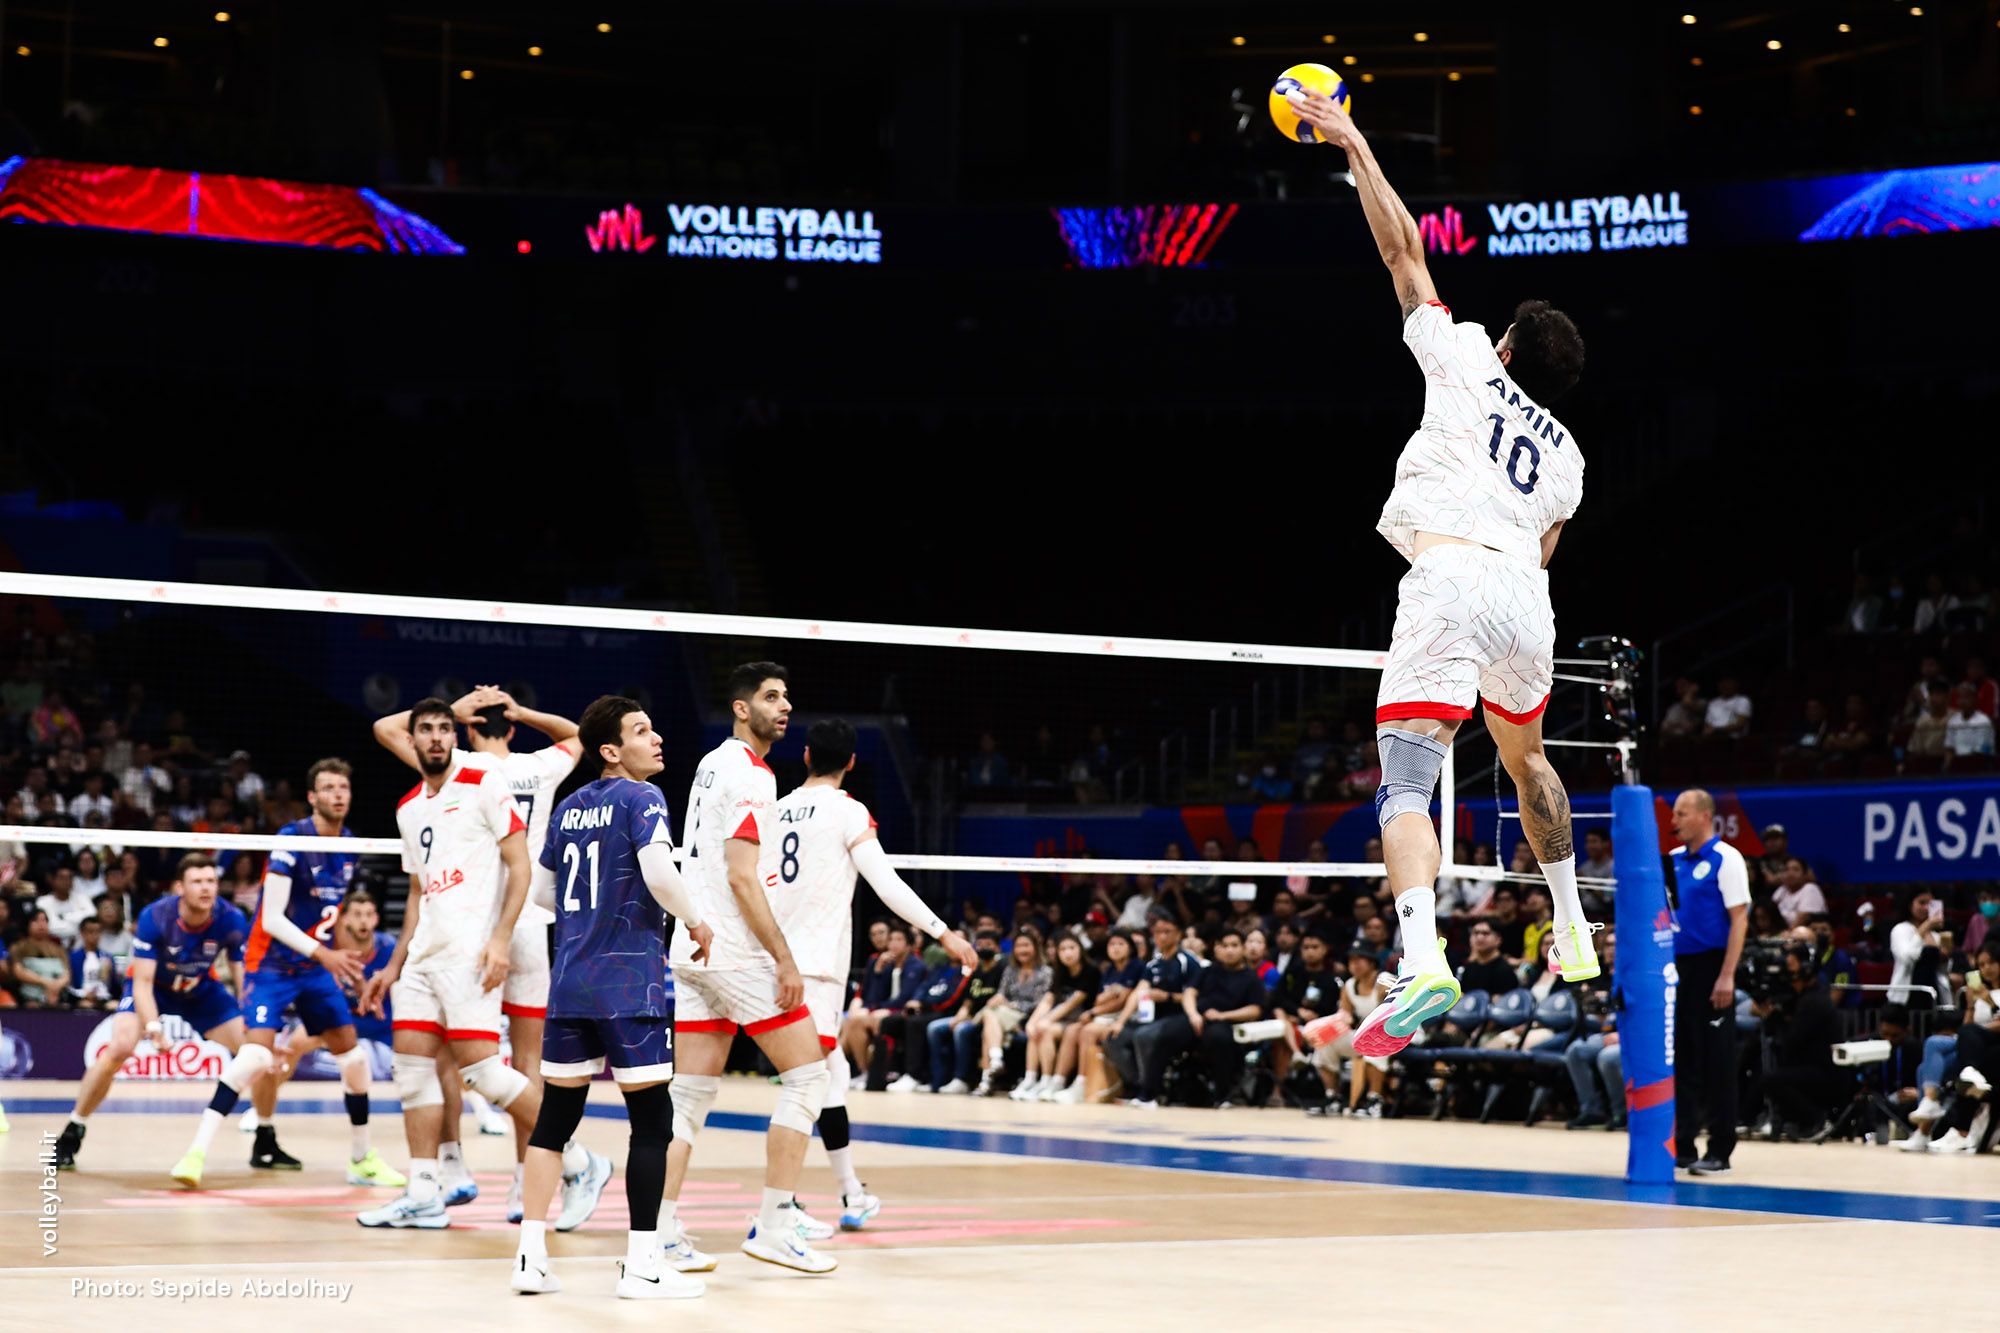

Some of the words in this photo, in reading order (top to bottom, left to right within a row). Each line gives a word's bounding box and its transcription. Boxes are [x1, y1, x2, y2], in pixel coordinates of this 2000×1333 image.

[667, 203, 882, 240] VOLLEYBALL
[1487, 191, 1688, 233] VOLLEYBALL
[667, 235, 778, 260] NATIONS
[785, 238, 882, 263] LEAGUE
[1487, 228, 1593, 257] NATIONS
[1600, 221, 1688, 251] LEAGUE
[1485, 377, 1565, 449] AMIN
[1487, 413, 1541, 495] 10
[560, 804, 613, 831] ARMAN
[1863, 797, 2000, 862] PASA
[420, 826, 434, 864] 9
[780, 831, 800, 884] 8
[562, 840, 600, 912] 21
[315, 904, 340, 941] 2
[256, 1005, 268, 1024] 2
